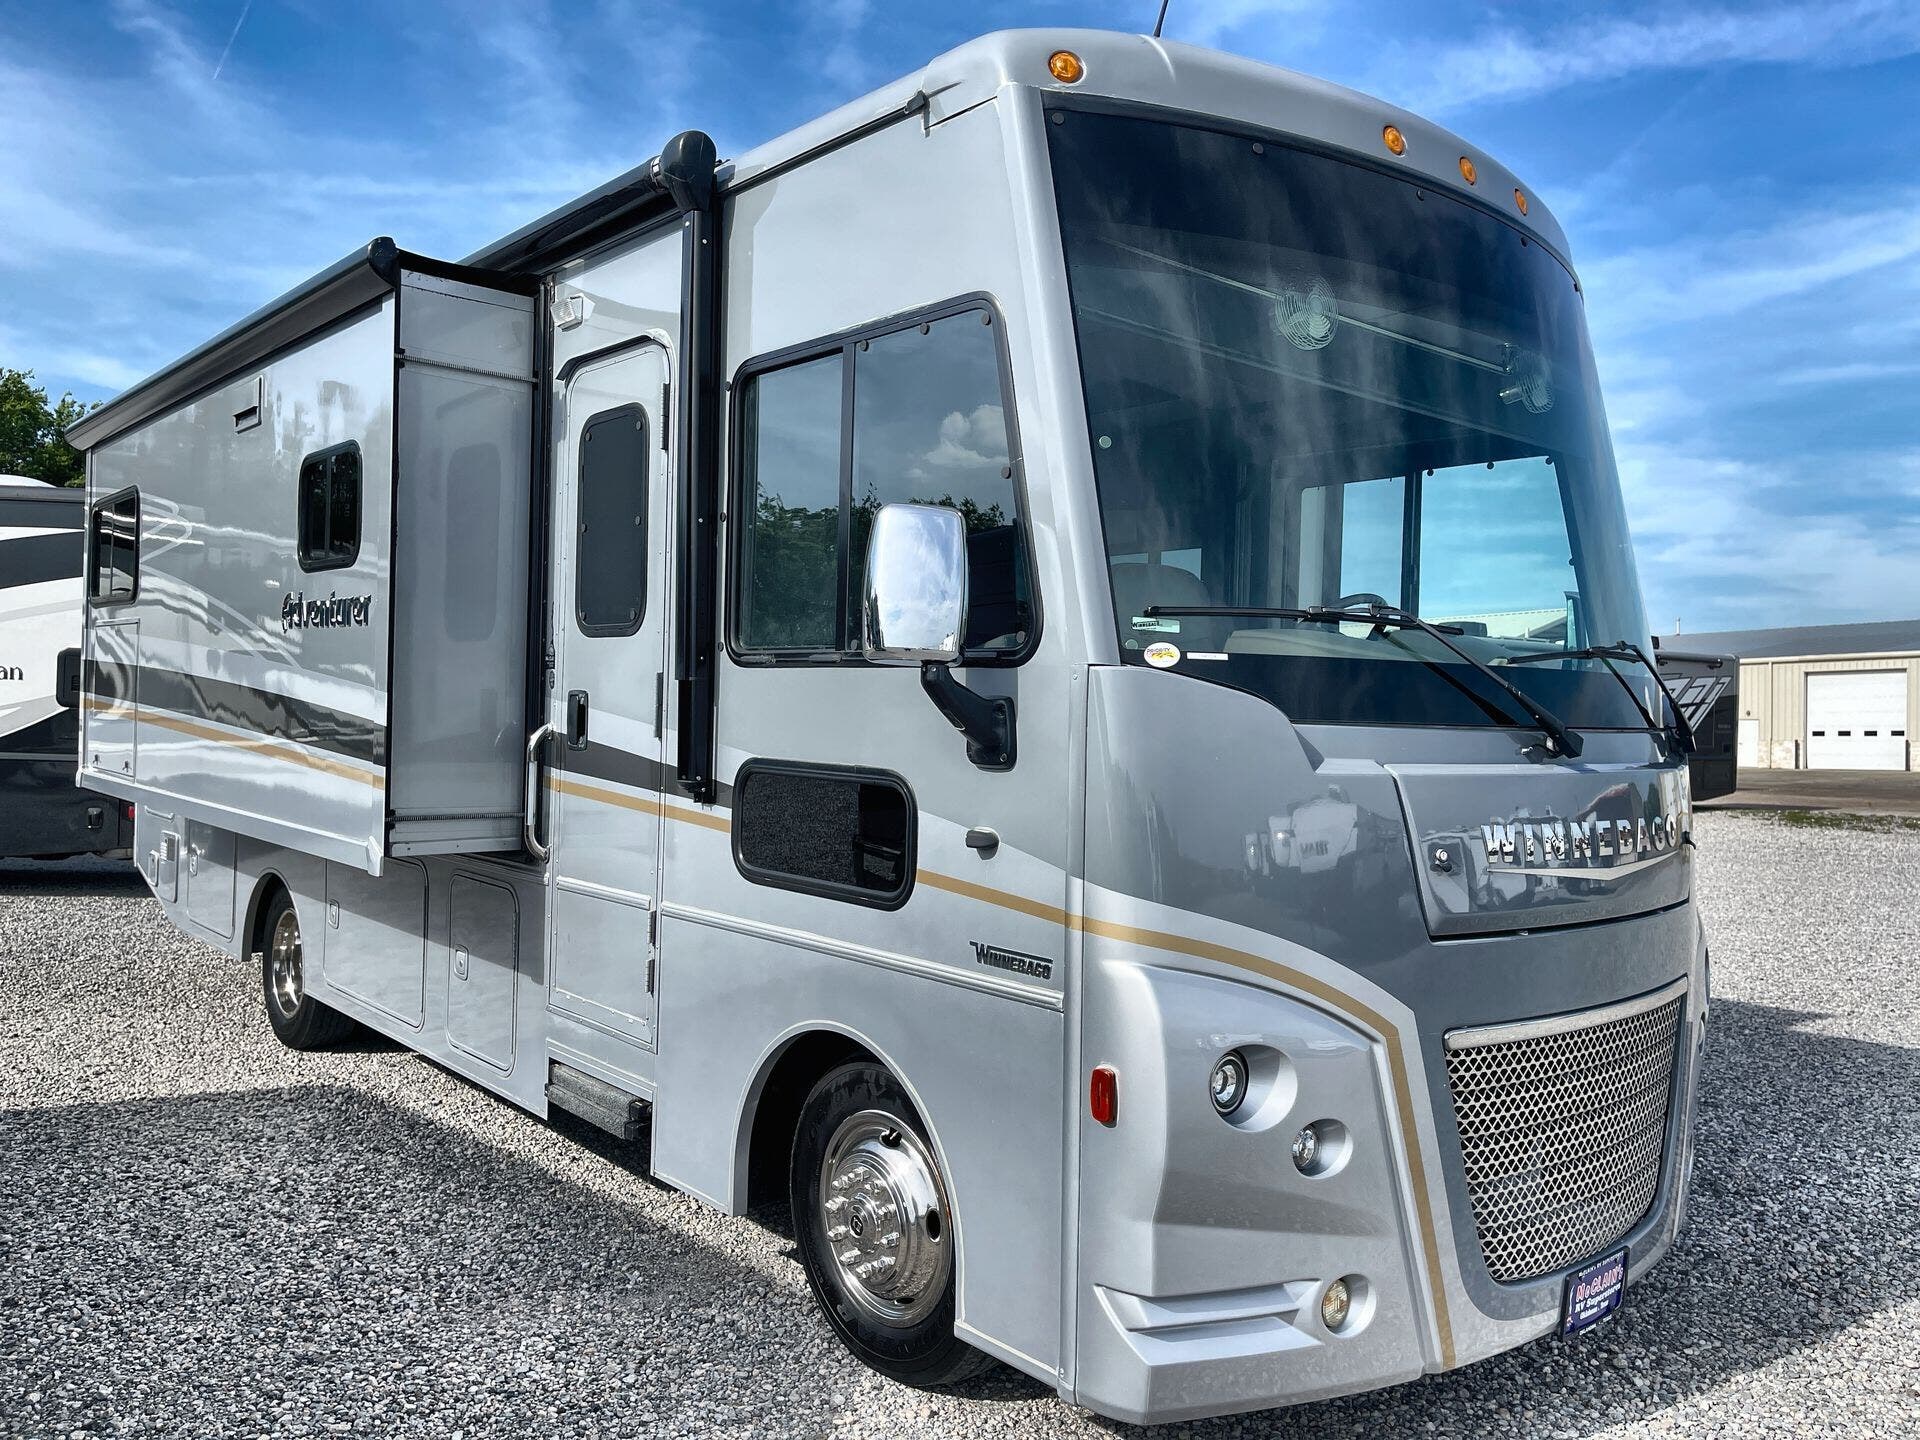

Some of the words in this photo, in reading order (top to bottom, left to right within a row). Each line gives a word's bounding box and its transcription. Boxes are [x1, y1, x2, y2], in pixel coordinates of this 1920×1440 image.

[281, 590, 372, 634] Adventurer
[1480, 813, 1677, 863] WINNEBAGO
[1574, 1300, 1586, 1314] RV
